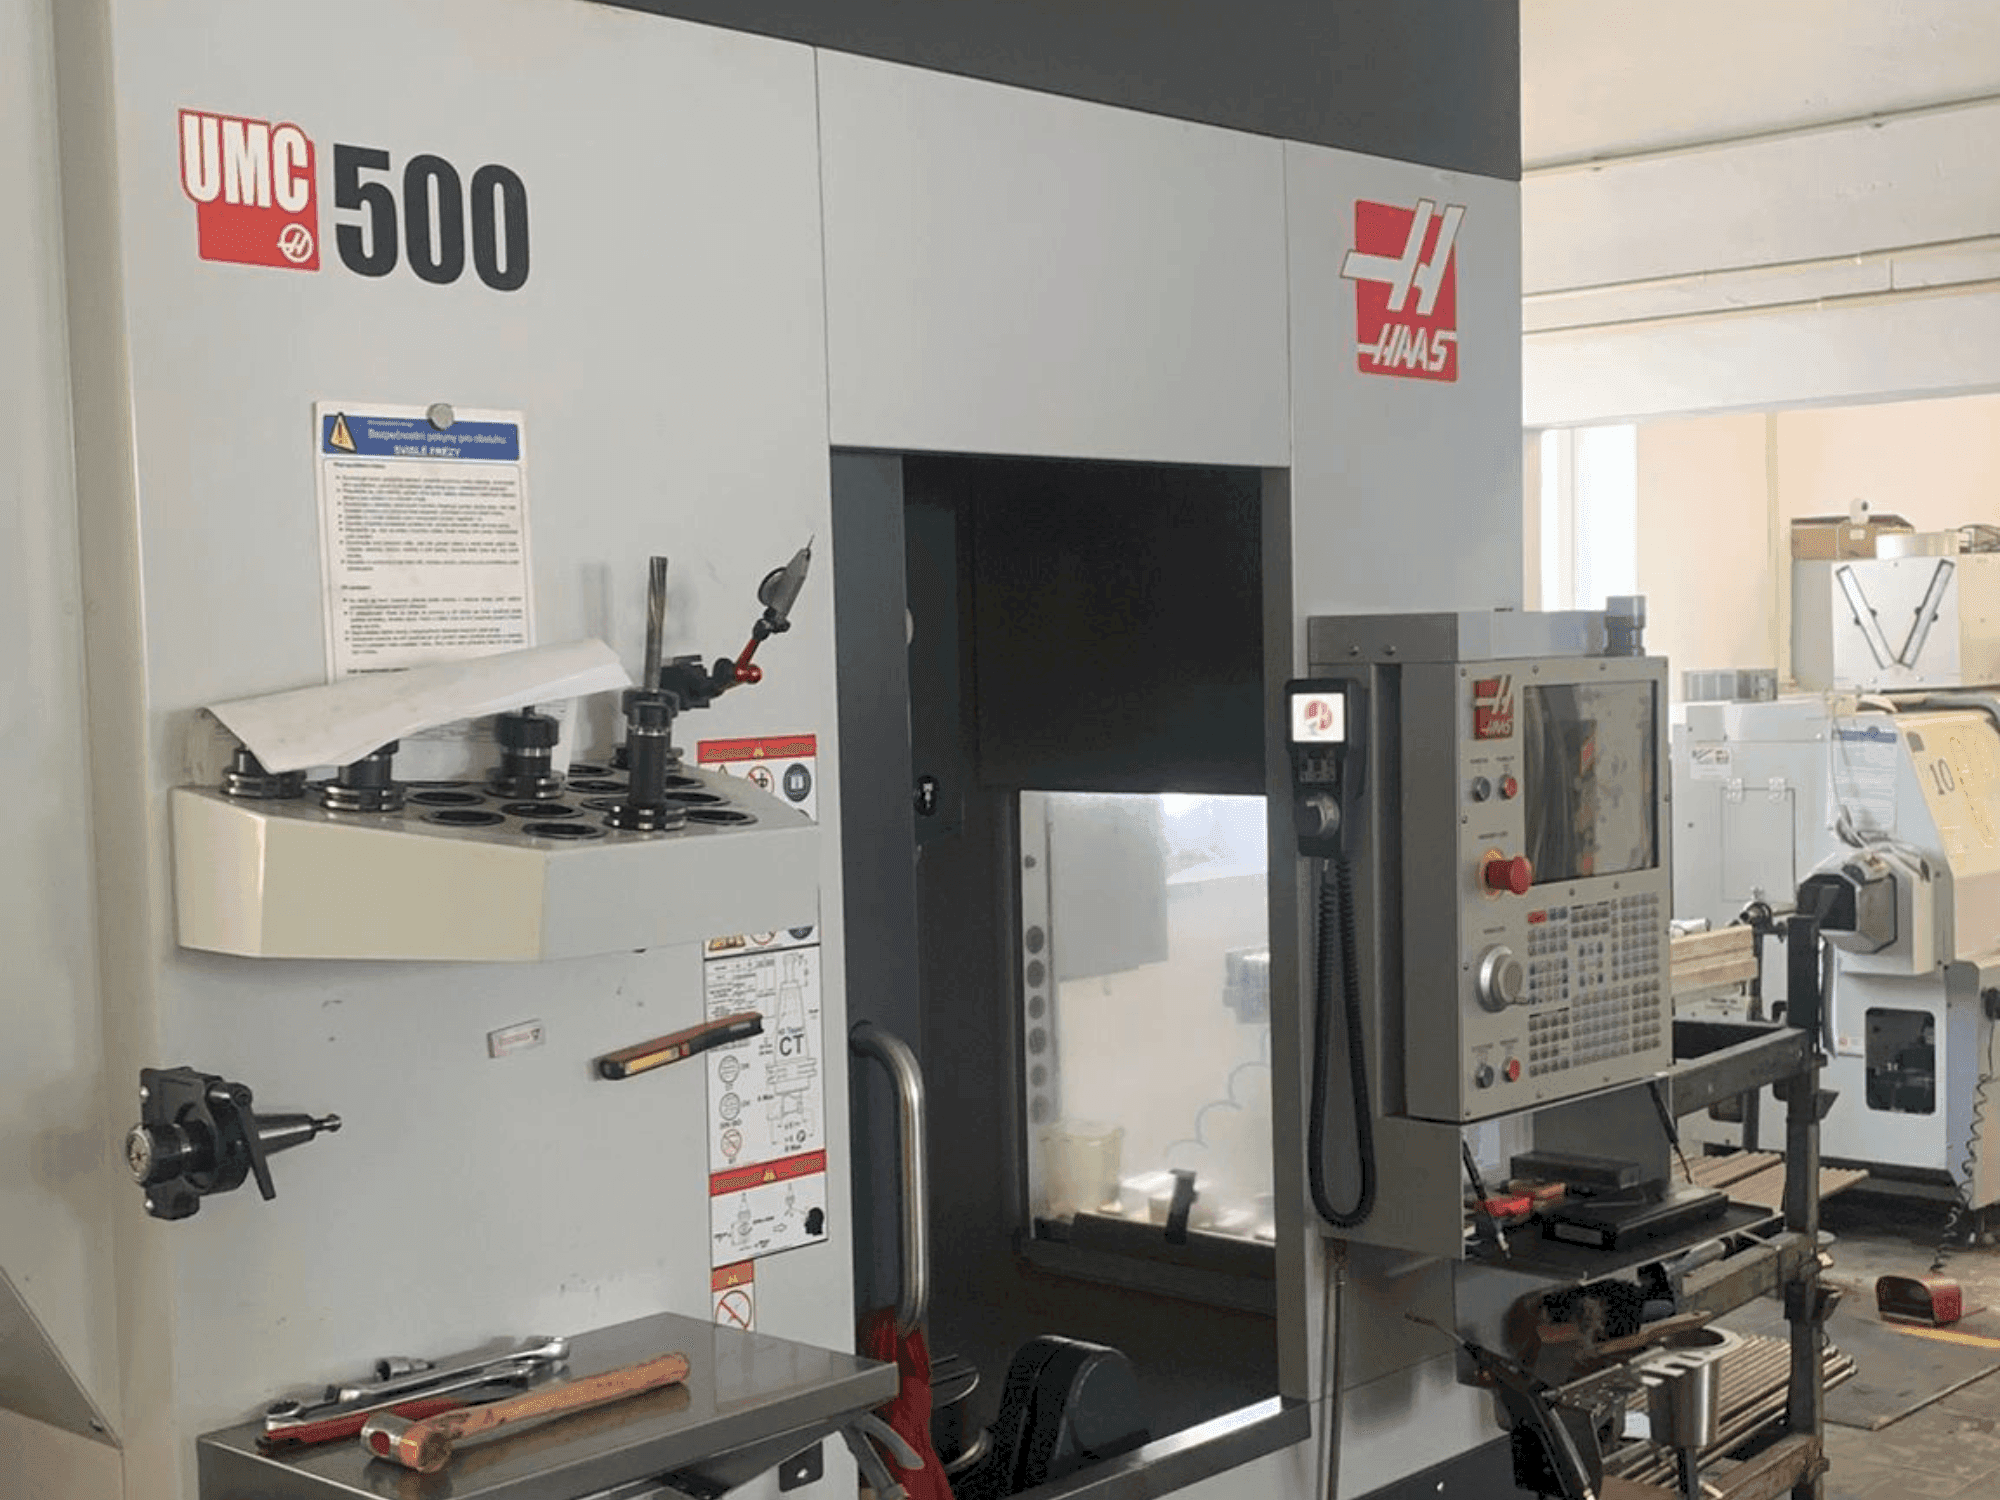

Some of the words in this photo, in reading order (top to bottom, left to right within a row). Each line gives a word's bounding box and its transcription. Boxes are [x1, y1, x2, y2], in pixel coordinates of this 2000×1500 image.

[182, 113, 309, 212] UMC
[333, 143, 531, 292] 500
[1357, 322, 1457, 372] HAAS
[1929, 758, 1955, 795] 10
[779, 1033, 805, 1057] CT
